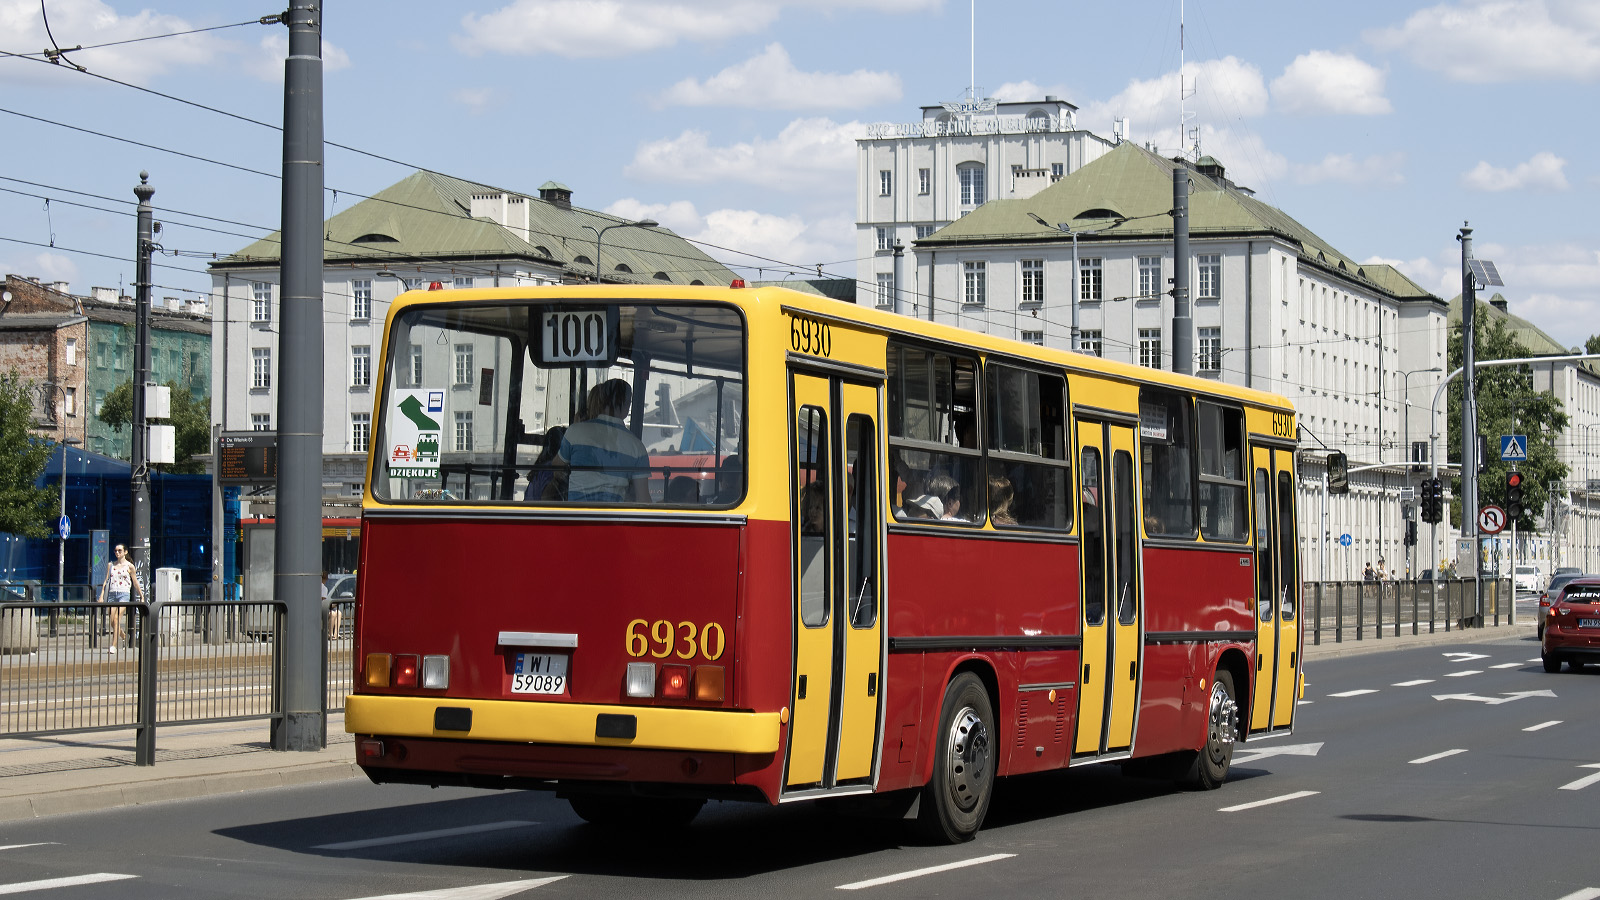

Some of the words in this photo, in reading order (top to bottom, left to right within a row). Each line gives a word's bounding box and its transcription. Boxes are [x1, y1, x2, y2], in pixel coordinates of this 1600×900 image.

[866, 123, 890, 136] PKP
[896, 120, 943, 136] POLSKIE
[947, 118, 980, 133] LINIE
[984, 116, 1046, 132] KOLEJOWE
[547, 314, 604, 357] 100
[791, 315, 831, 358] 6930
[1272, 411, 1293, 437] 6930
[390, 468, 438, 478] DZIĘKUJĘ
[625, 618, 726, 661] 6930
[514, 674, 563, 692] 59089
